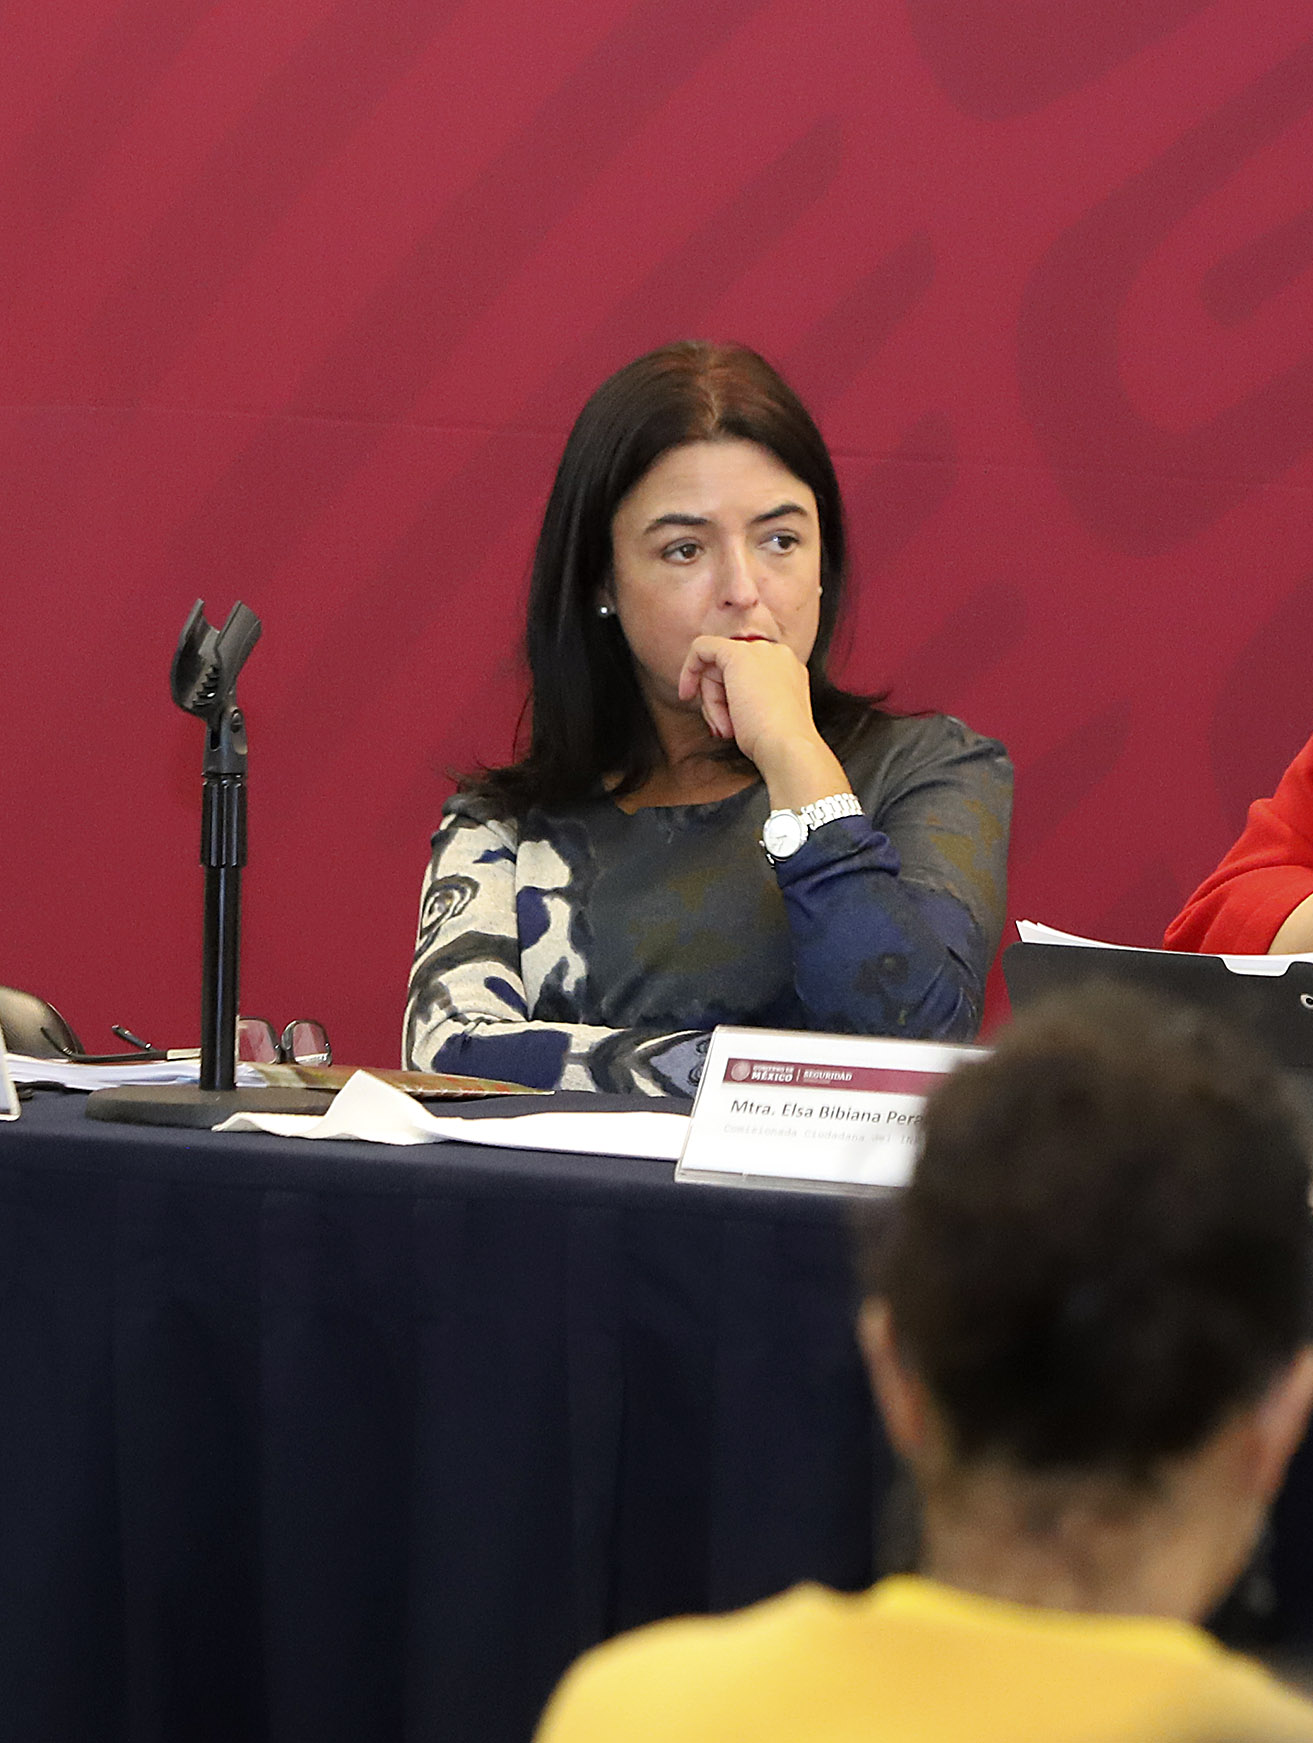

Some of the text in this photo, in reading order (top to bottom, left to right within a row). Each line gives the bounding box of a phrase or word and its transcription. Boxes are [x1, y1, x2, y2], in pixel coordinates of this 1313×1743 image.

[751, 1070, 793, 1082] MÉXICO
[803, 1070, 853, 1081] SEGURIDAD
[731, 1100, 924, 1126] Mtra. Elsa Bibiana Pera
